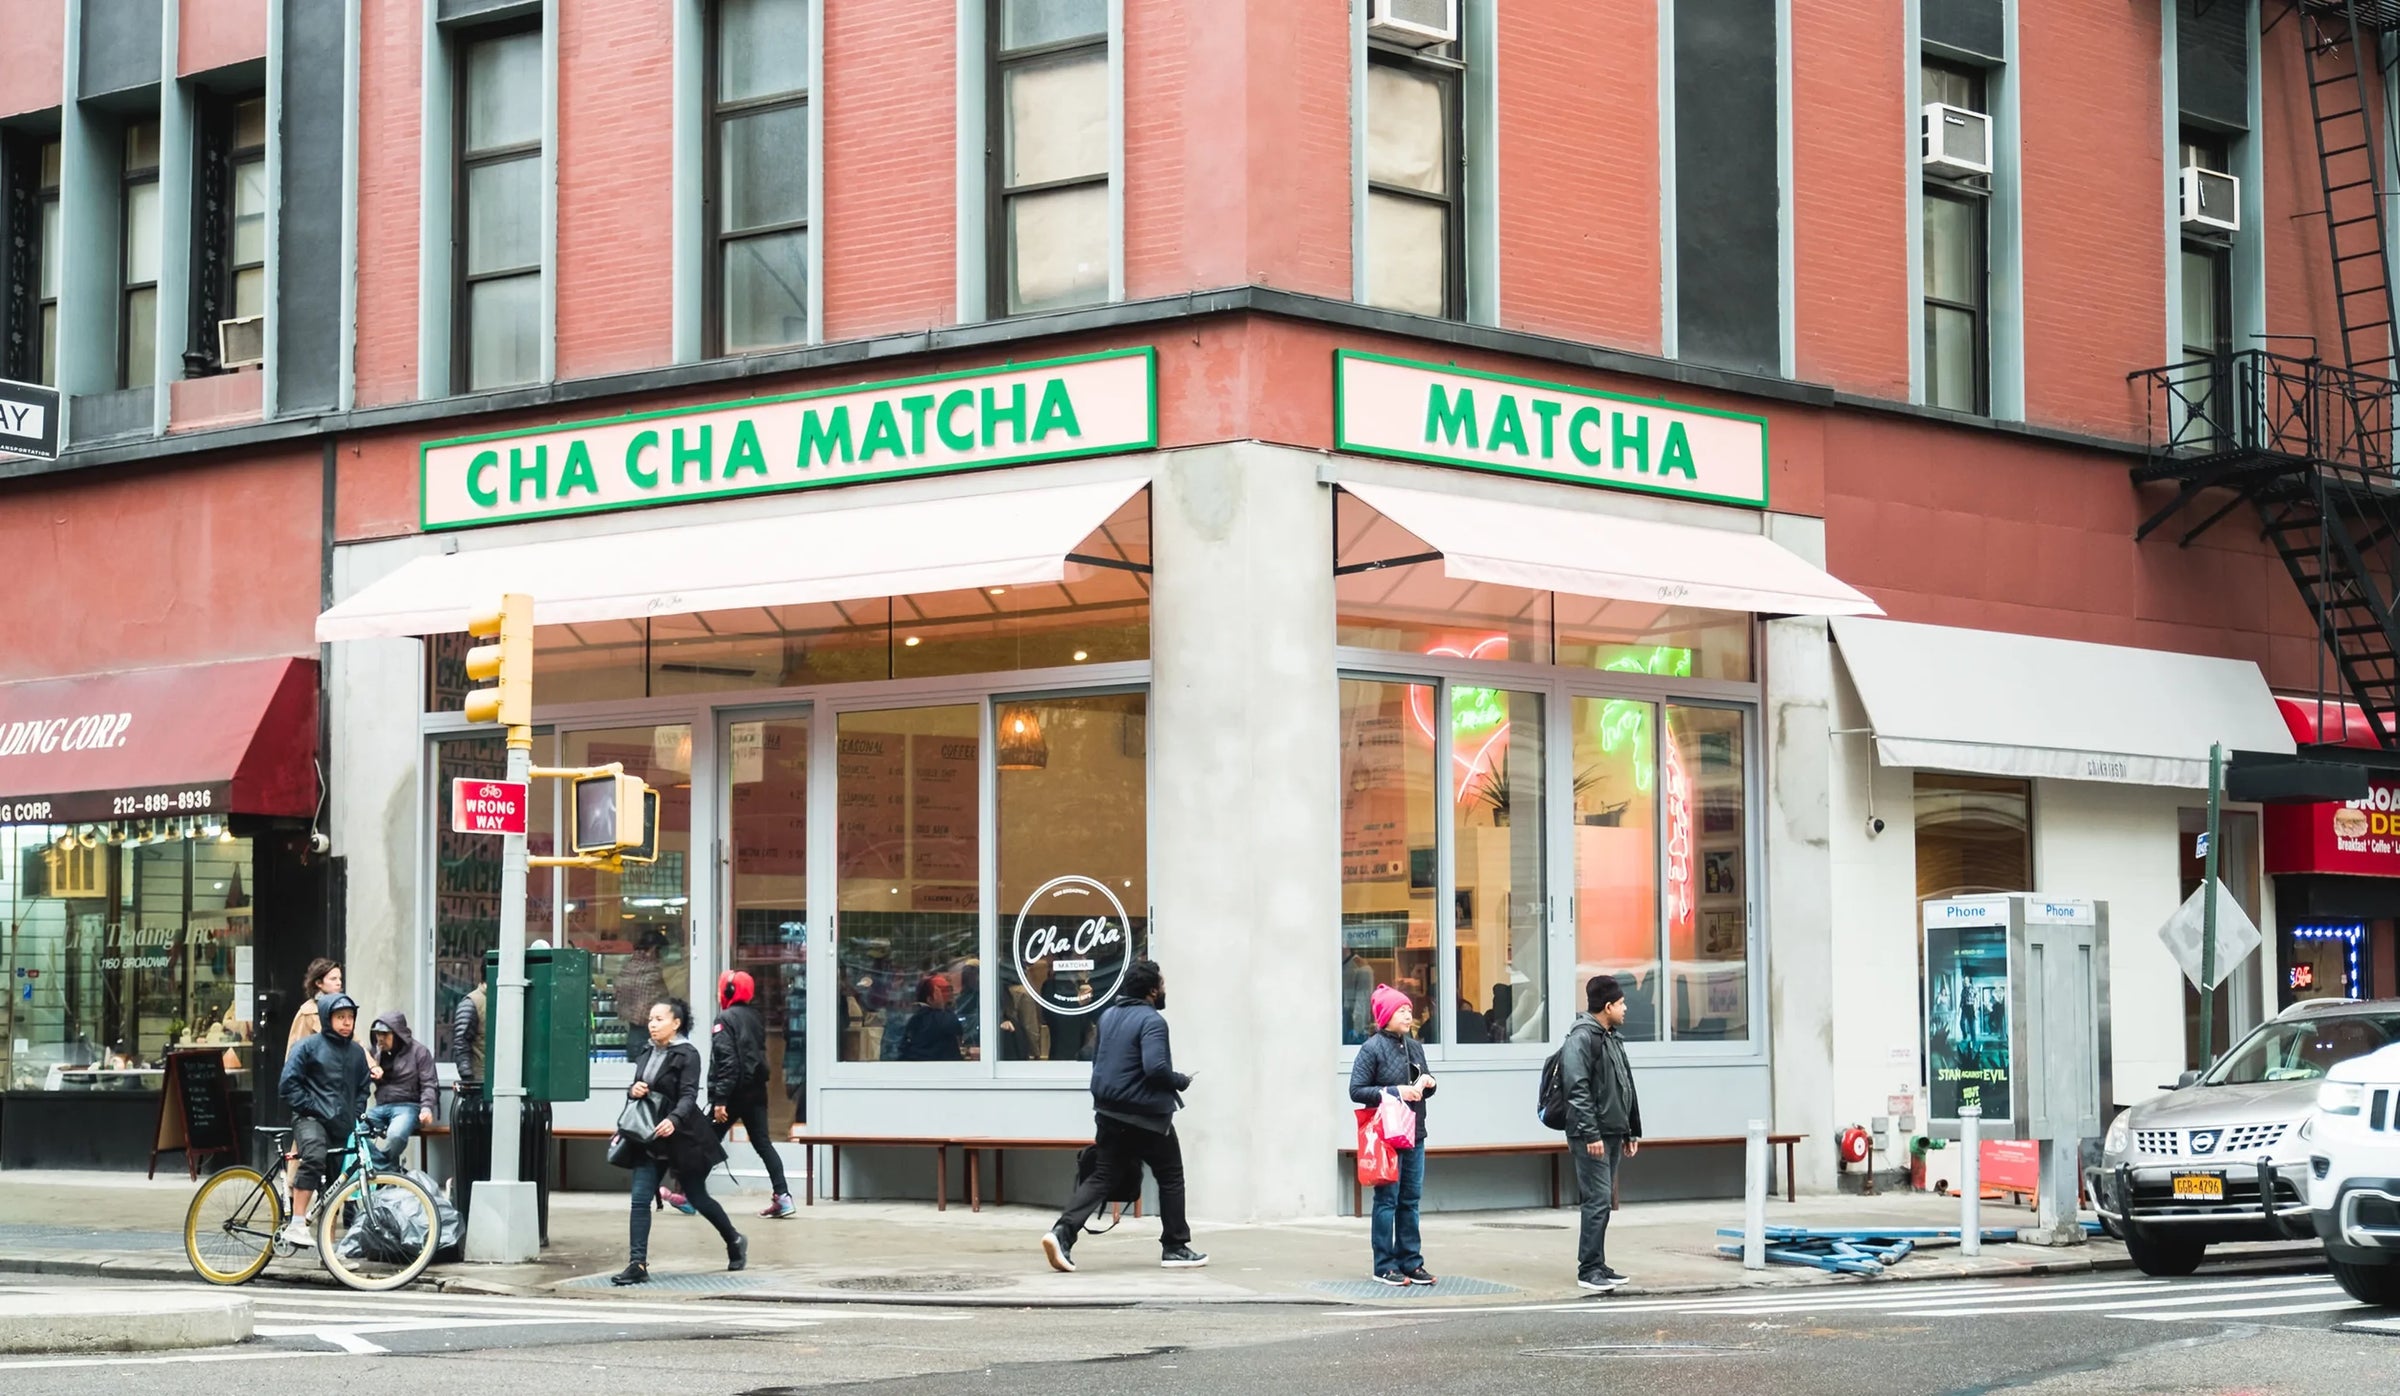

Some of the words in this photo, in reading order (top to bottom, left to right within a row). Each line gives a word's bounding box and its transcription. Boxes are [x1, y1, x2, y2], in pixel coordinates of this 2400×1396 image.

[1425, 383, 1698, 480] MATCHA
[466, 441, 598, 508] CHA
[625, 420, 769, 488] CHA
[798, 379, 1081, 468] MATCHA
[61, 712, 132, 750] CORP.
[113, 789, 212, 815] 212-889-8936
[466, 800, 515, 815] WRONG
[14, 802, 53, 821] CORP.
[476, 815, 504, 829] WAY
[2337, 837, 2367, 853] Breakfast
[2371, 839, 2391, 853] Coffee
[1947, 905, 1986, 918] Phone
[2046, 904, 2075, 918] Phone
[1025, 925, 1071, 964] Cha
[1074, 916, 1120, 955] Cha
[123, 956, 171, 969] BROADWAY
[1938, 1068, 1961, 1081] STAN
[1961, 1070, 1983, 1079] AGAINST
[1983, 1068, 2007, 1084] EVIL
